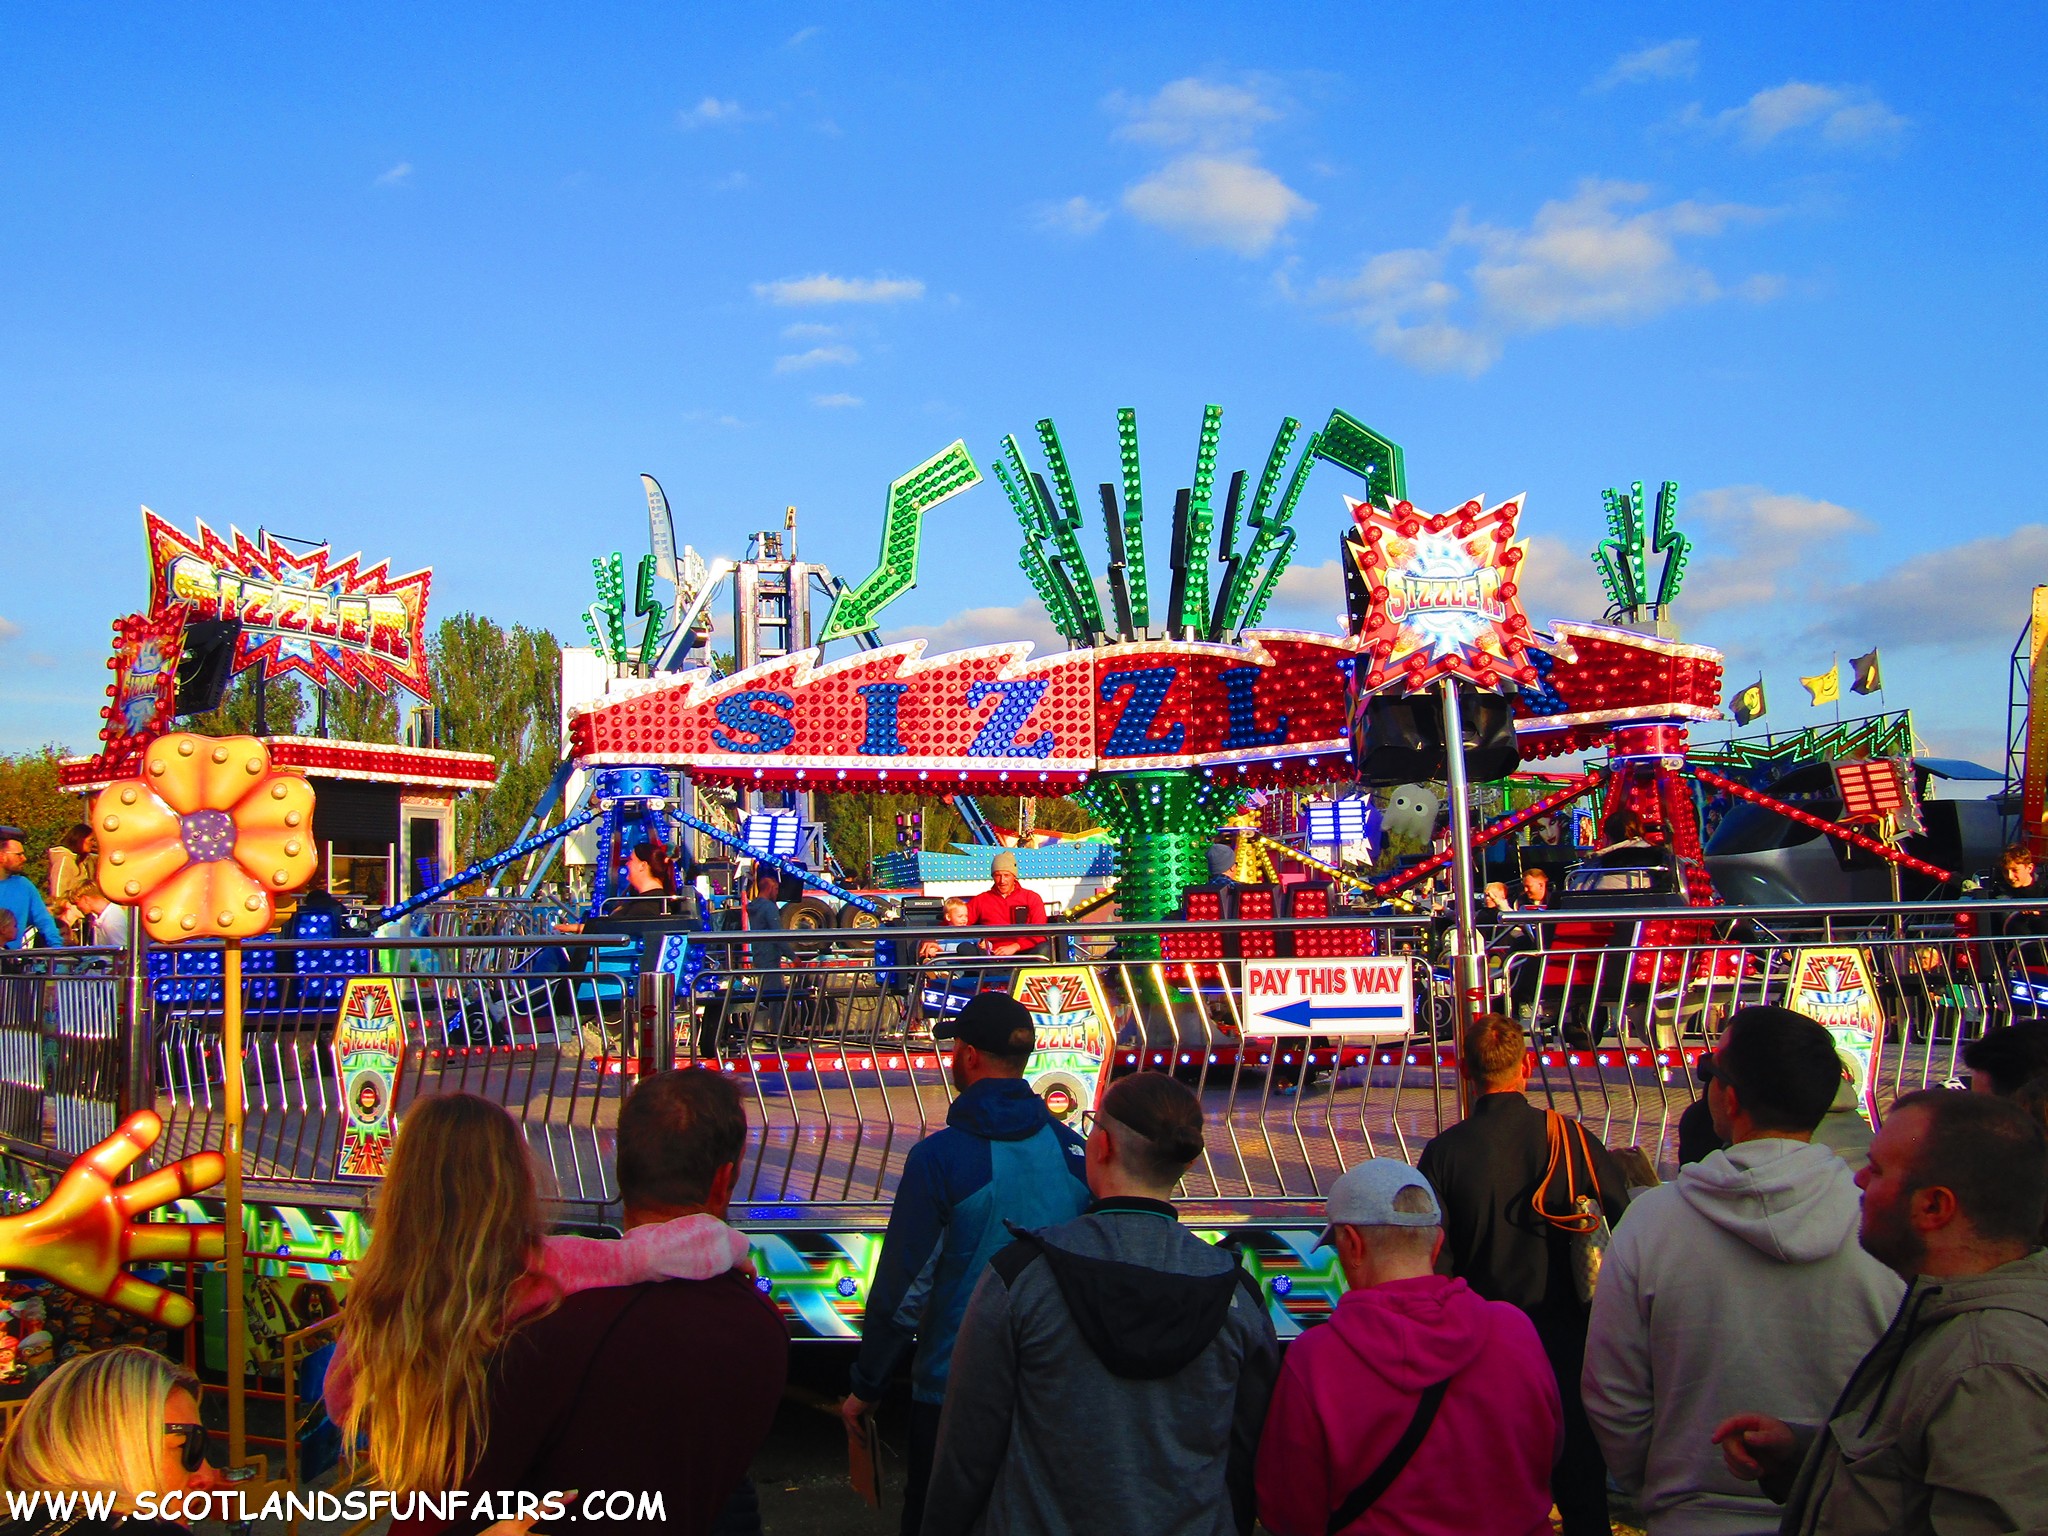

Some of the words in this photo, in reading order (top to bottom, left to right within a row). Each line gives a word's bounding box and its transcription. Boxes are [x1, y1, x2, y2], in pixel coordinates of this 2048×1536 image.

[168, 552, 412, 666] SIZZLER
[1384, 566, 1507, 624] SIZZLER
[1249, 967, 1291, 996] PAY
[1296, 966, 1348, 995] THIS
[1351, 965, 1404, 995] WAY
[338, 1021, 401, 1064] SIZZLER
[472, 1018, 484, 1035] 2
[1034, 1014, 1105, 1062] ZZLER
